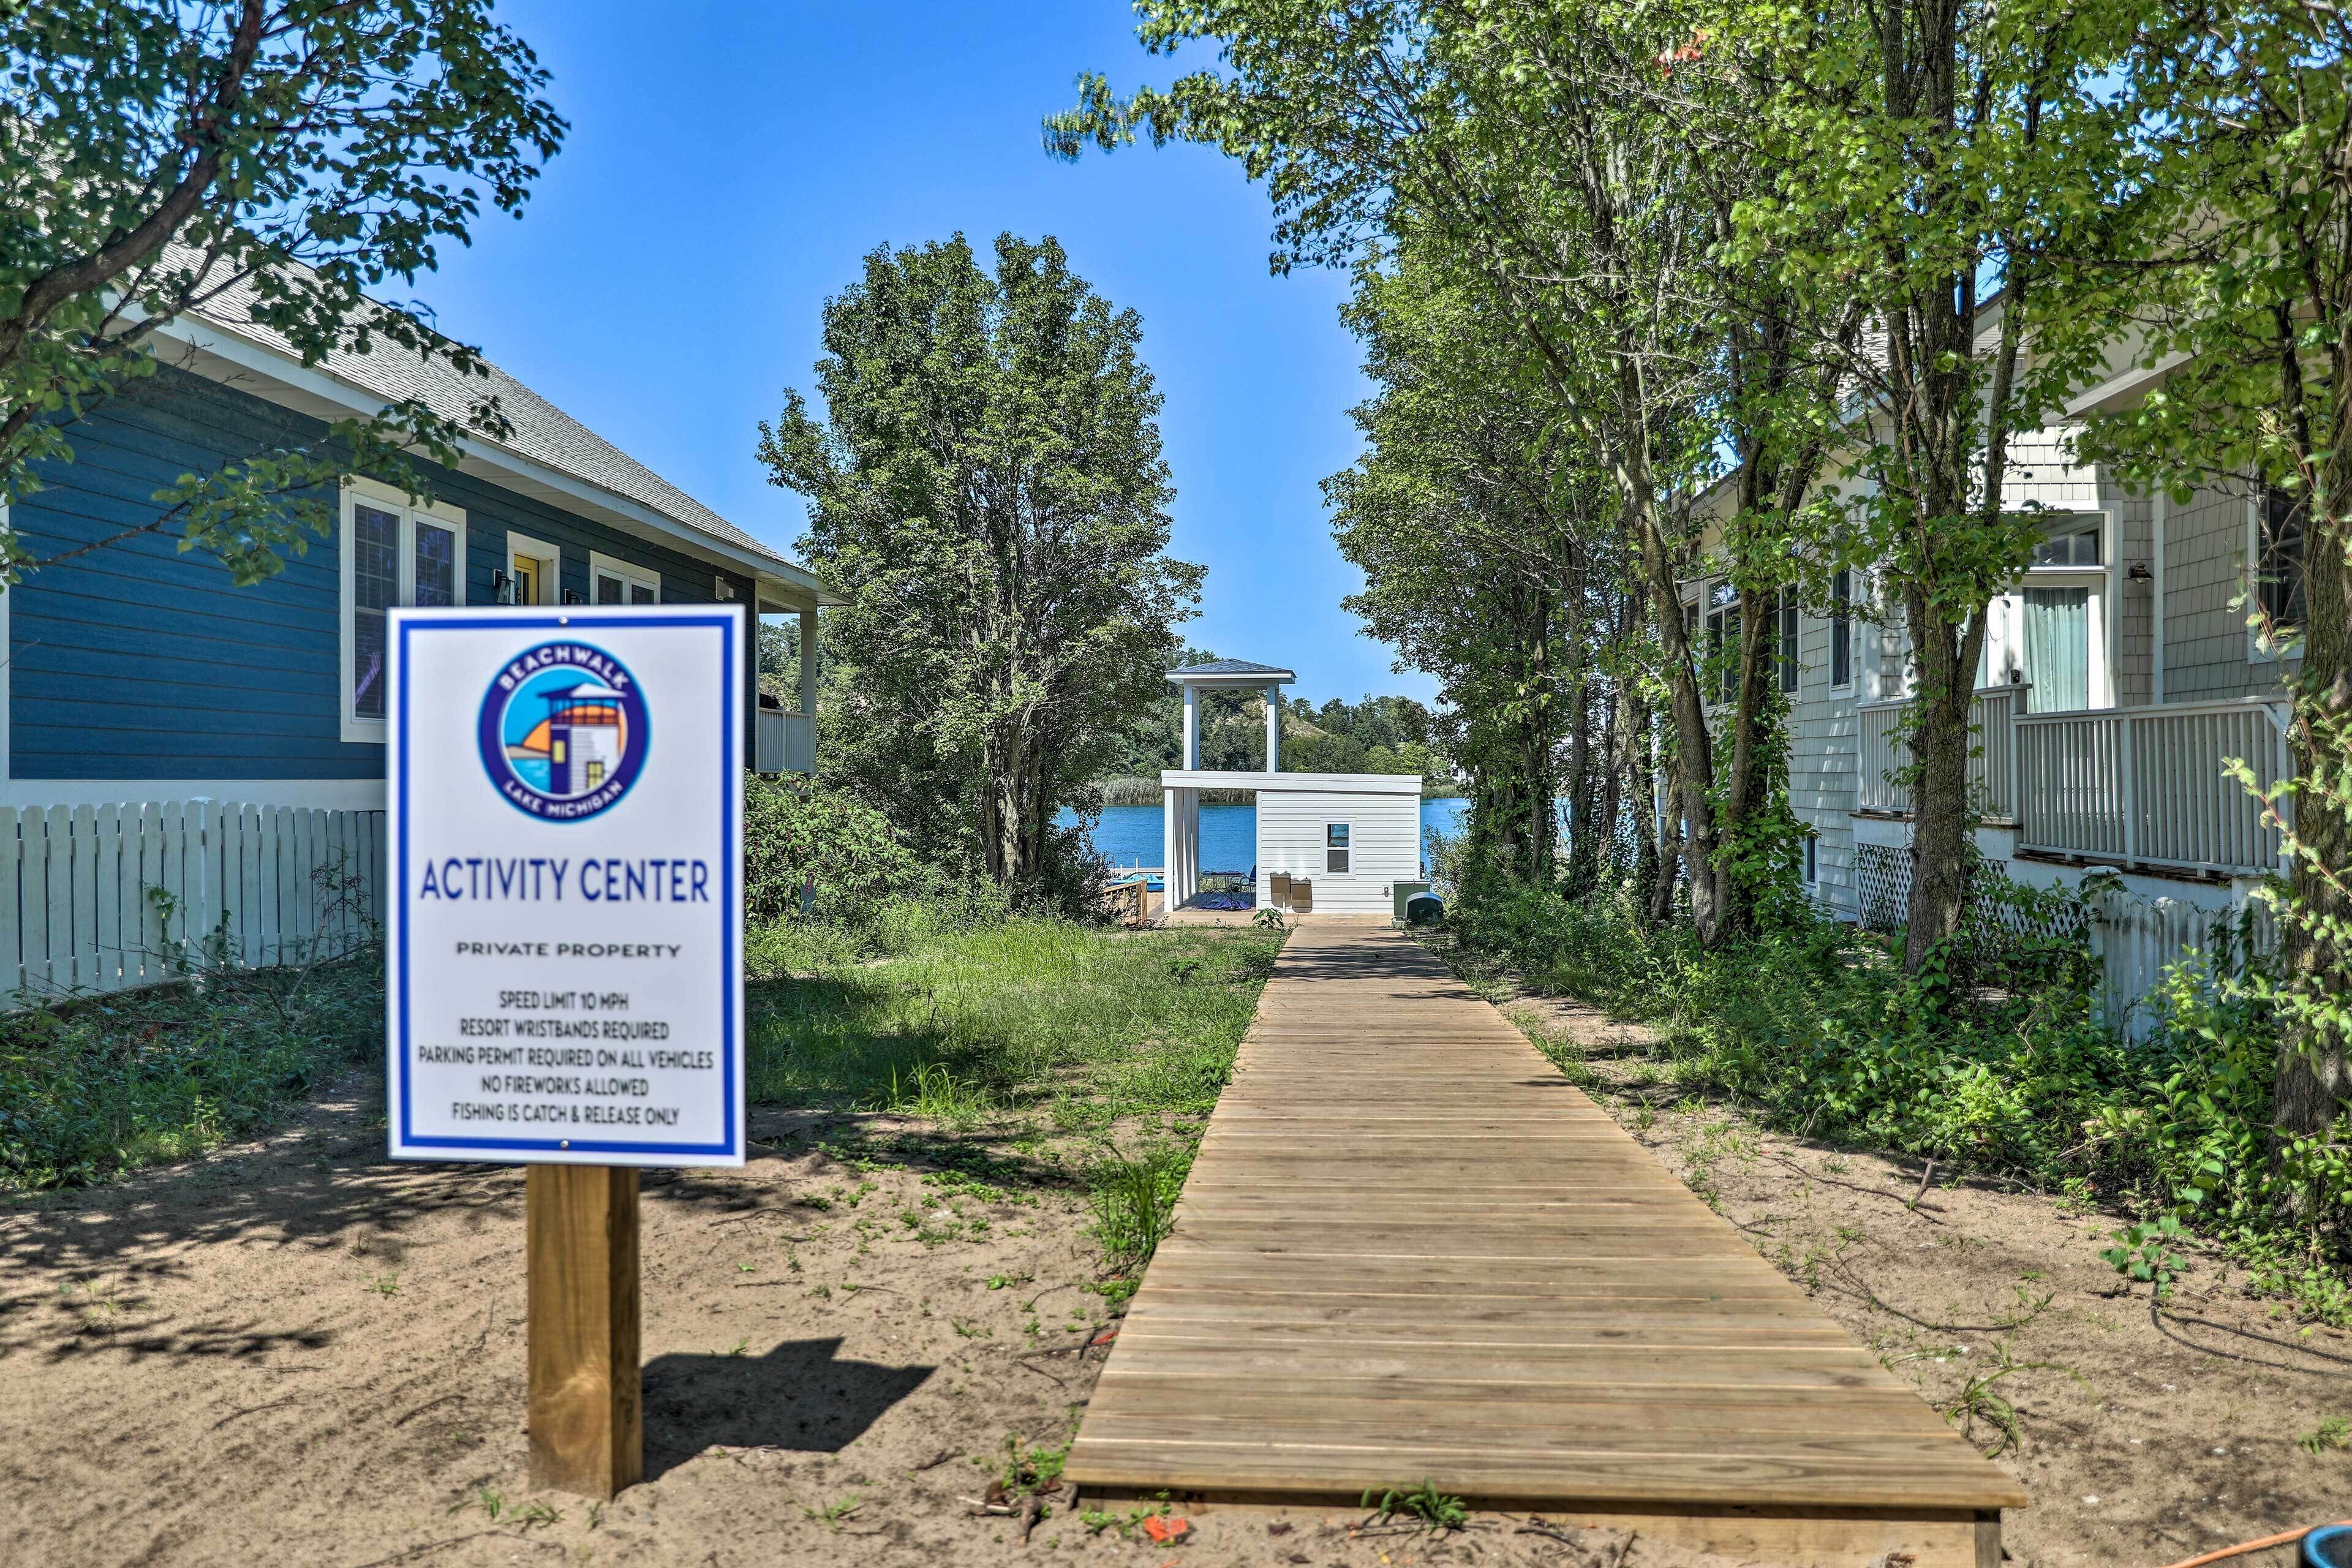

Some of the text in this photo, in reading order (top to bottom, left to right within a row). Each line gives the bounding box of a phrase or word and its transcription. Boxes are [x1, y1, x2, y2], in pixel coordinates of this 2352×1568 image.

[499, 646, 629, 691] BEACHWALK
[504, 781, 624, 816] LAKE MICHIGAN
[420, 858, 709, 902] ACTIVITY CENTER
[456, 941, 680, 958] PRIVATE PROPERTY
[499, 990, 628, 1011] SPEED LIMIT 10 MPH
[460, 1018, 669, 1041] RESORT WRISTBANDS REQUIRED
[419, 1046, 713, 1069] PARKING PERMIT REQUIRED ON ALL VEHICLES
[481, 1075, 649, 1097] NO FIREWORKS ALLOWED
[452, 1102, 679, 1126] FISHING IS CATCH & RELEASE ONLY
